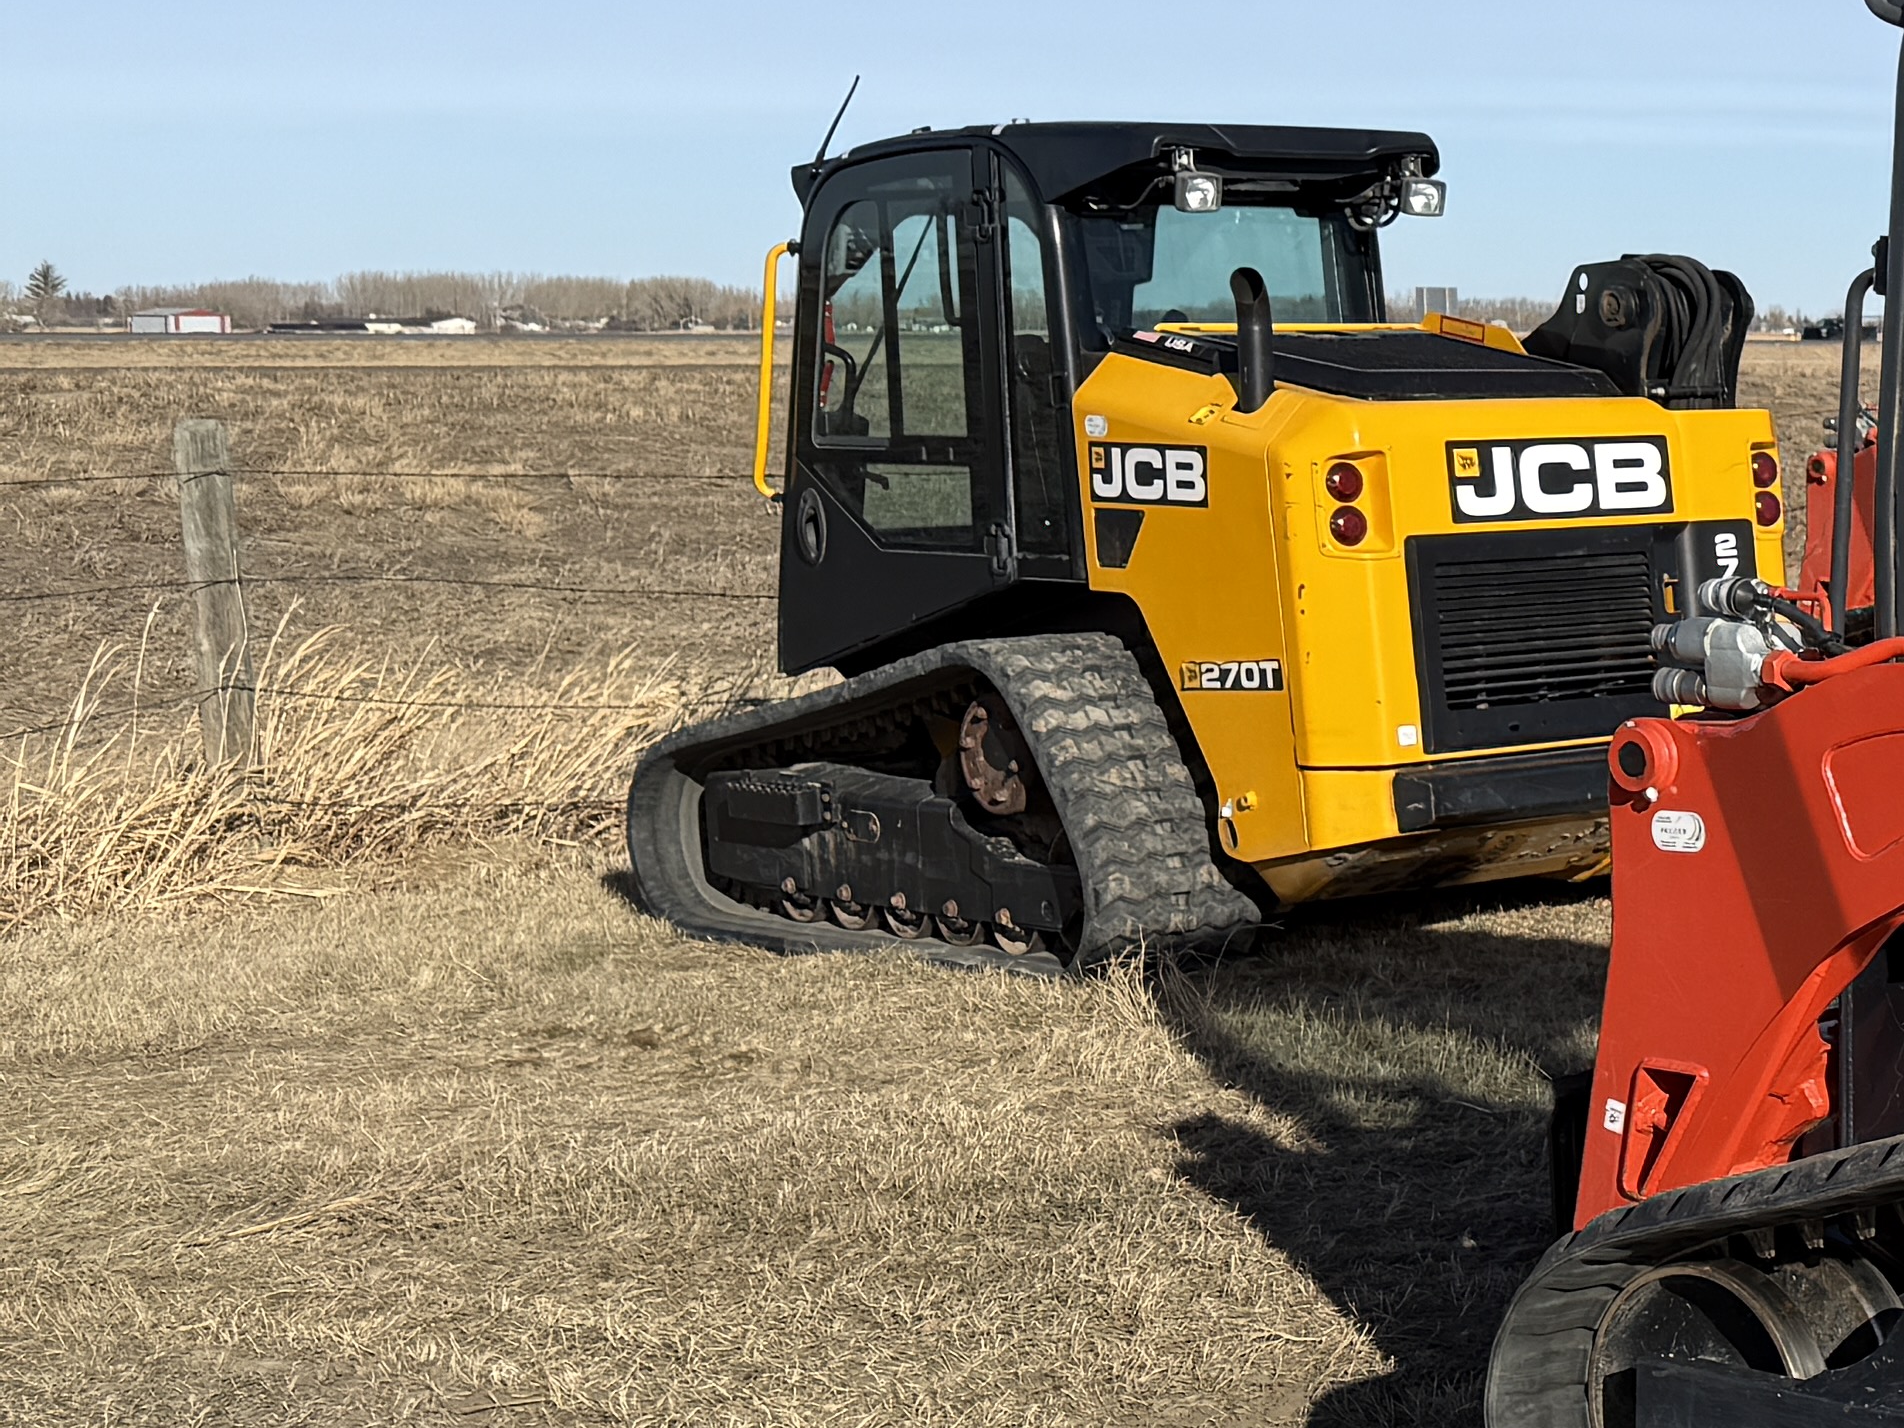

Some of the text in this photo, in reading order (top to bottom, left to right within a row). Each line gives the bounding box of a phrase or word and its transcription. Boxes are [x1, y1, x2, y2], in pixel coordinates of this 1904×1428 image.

[1164, 336, 1195, 353] USA
[1092, 447, 1206, 502] JCB
[1456, 442, 1667, 516] JCB
[1201, 661, 1279, 689] 270T
